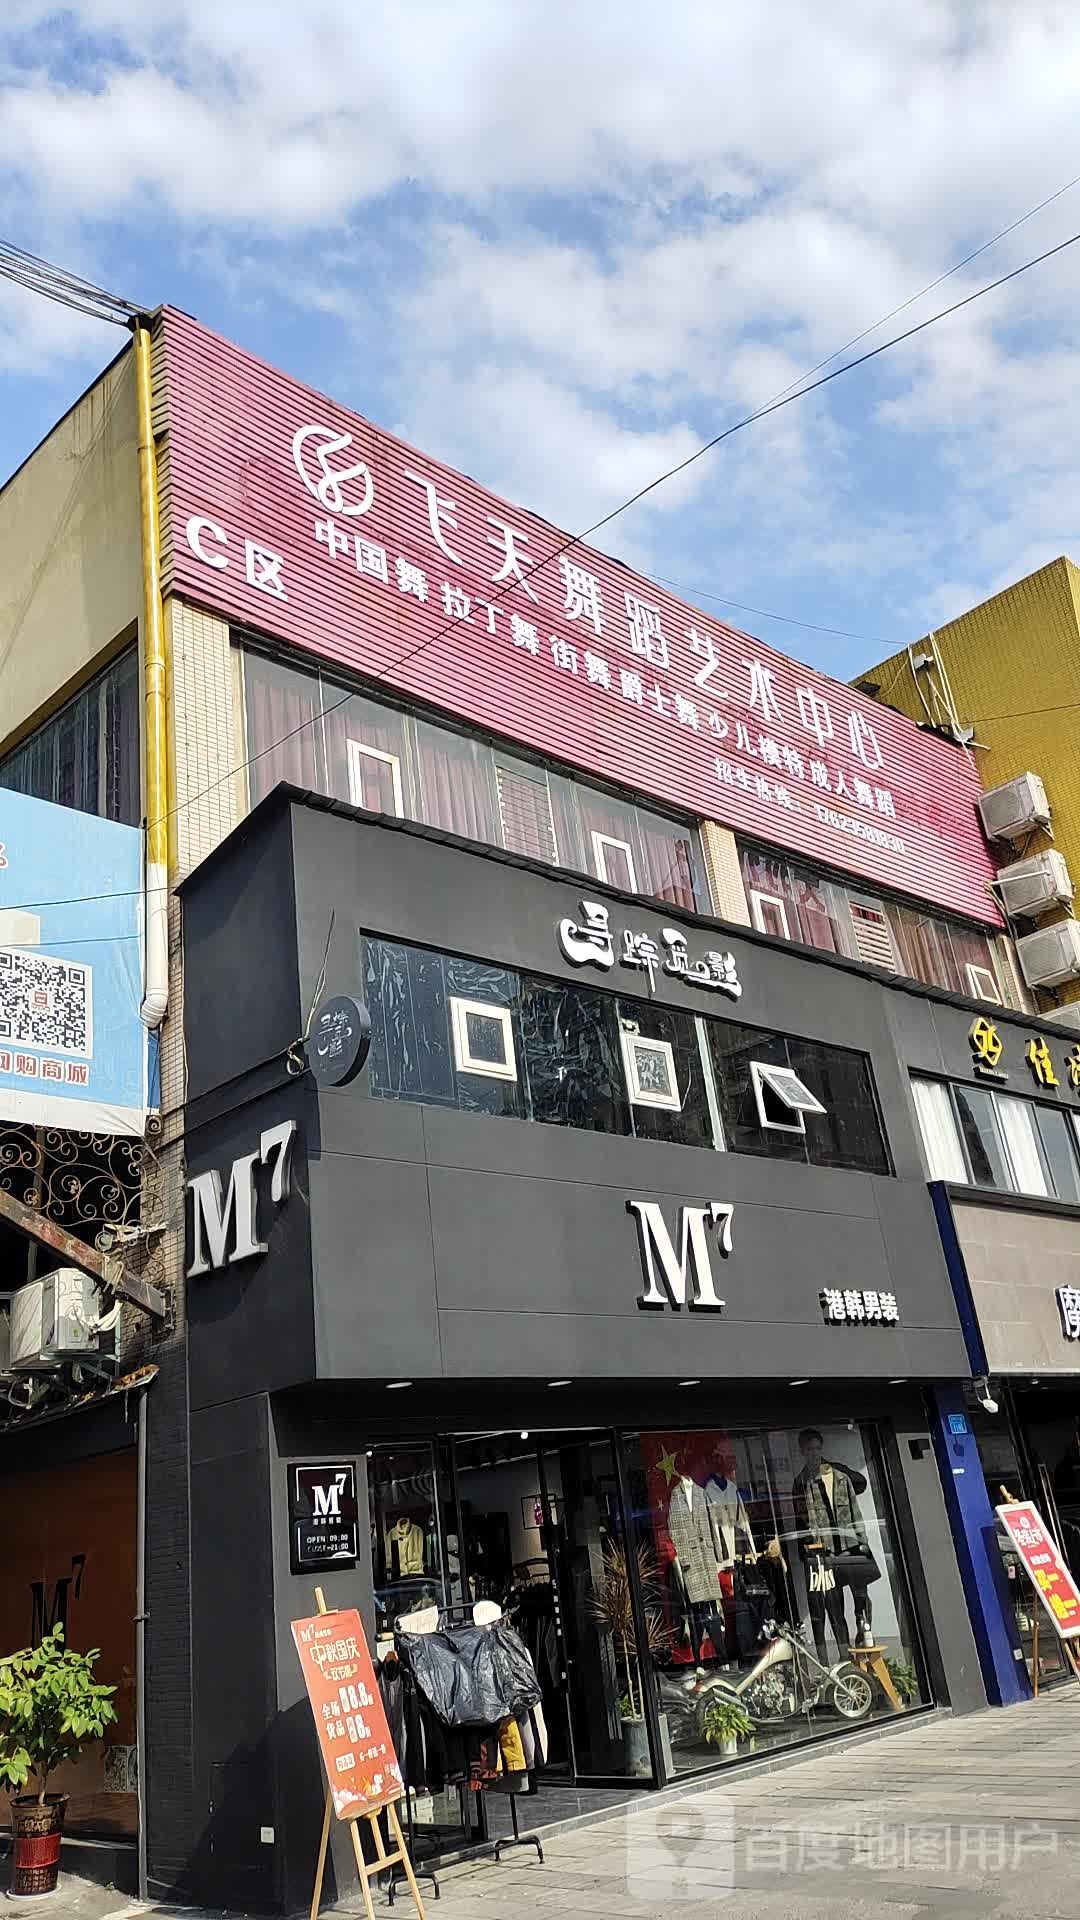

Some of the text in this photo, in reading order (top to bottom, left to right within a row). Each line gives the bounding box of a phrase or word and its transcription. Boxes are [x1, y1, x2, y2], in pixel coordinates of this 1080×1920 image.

[185, 515, 289, 601] C区
[403, 469, 885, 771] 飞天舞蹈艺术中心
[625, 1200, 735, 1311] M7
[822, 1287, 900, 1322] 港韩男装
[311, 1473, 347, 1516] M7
[309, 1636, 362, 1672] 中秋国庆
